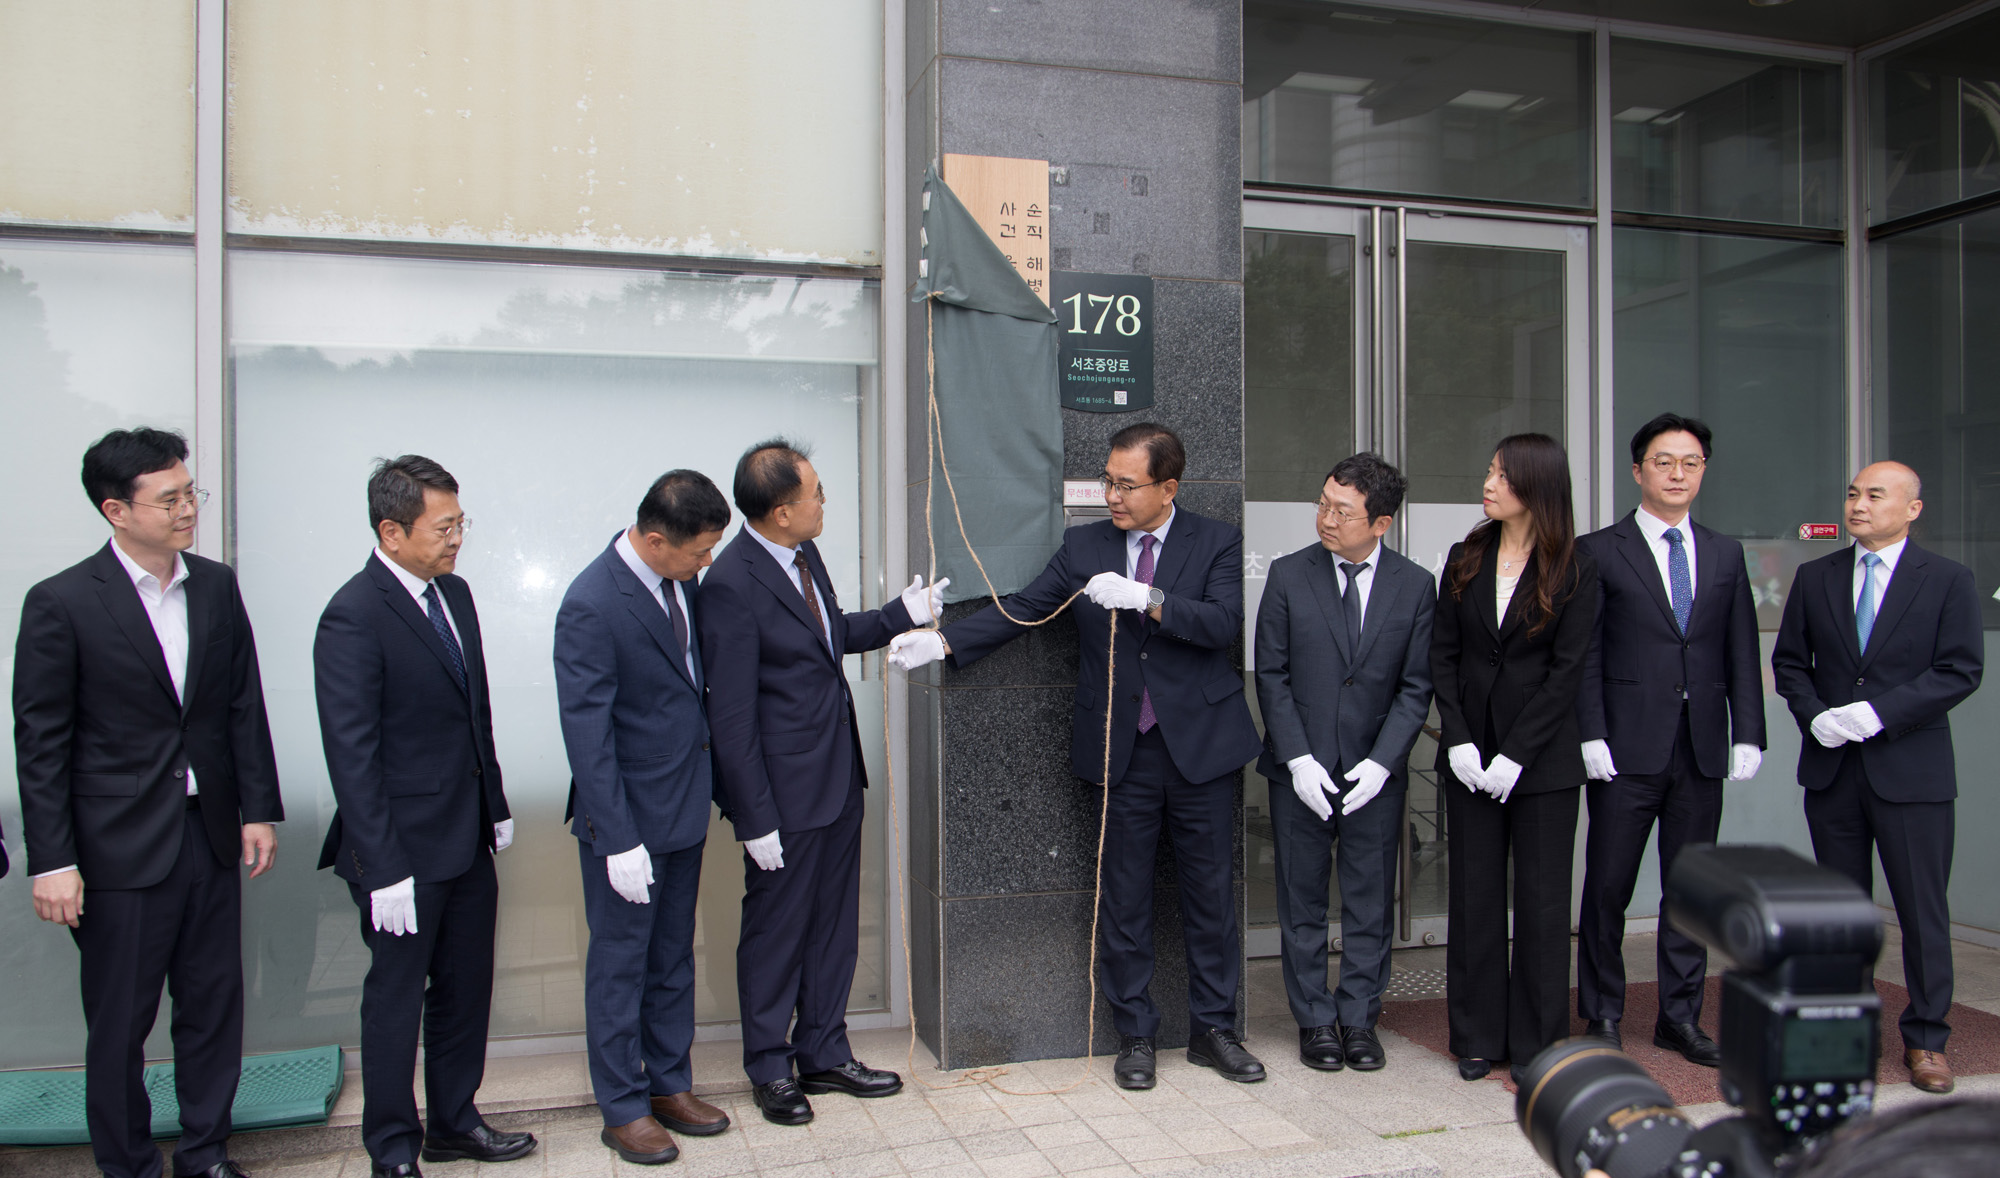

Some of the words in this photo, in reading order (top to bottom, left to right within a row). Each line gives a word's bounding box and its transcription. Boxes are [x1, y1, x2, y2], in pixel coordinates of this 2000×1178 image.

[1000, 201, 1017, 238] 사건
[1026, 203, 1043, 239] 순직
[1026, 256, 1043, 293] 해병
[1062, 292, 1142, 336] 178
[1067, 373, 1136, 384] Seochojungang-ro
[1071, 357, 1130, 373] 서초중앙로
